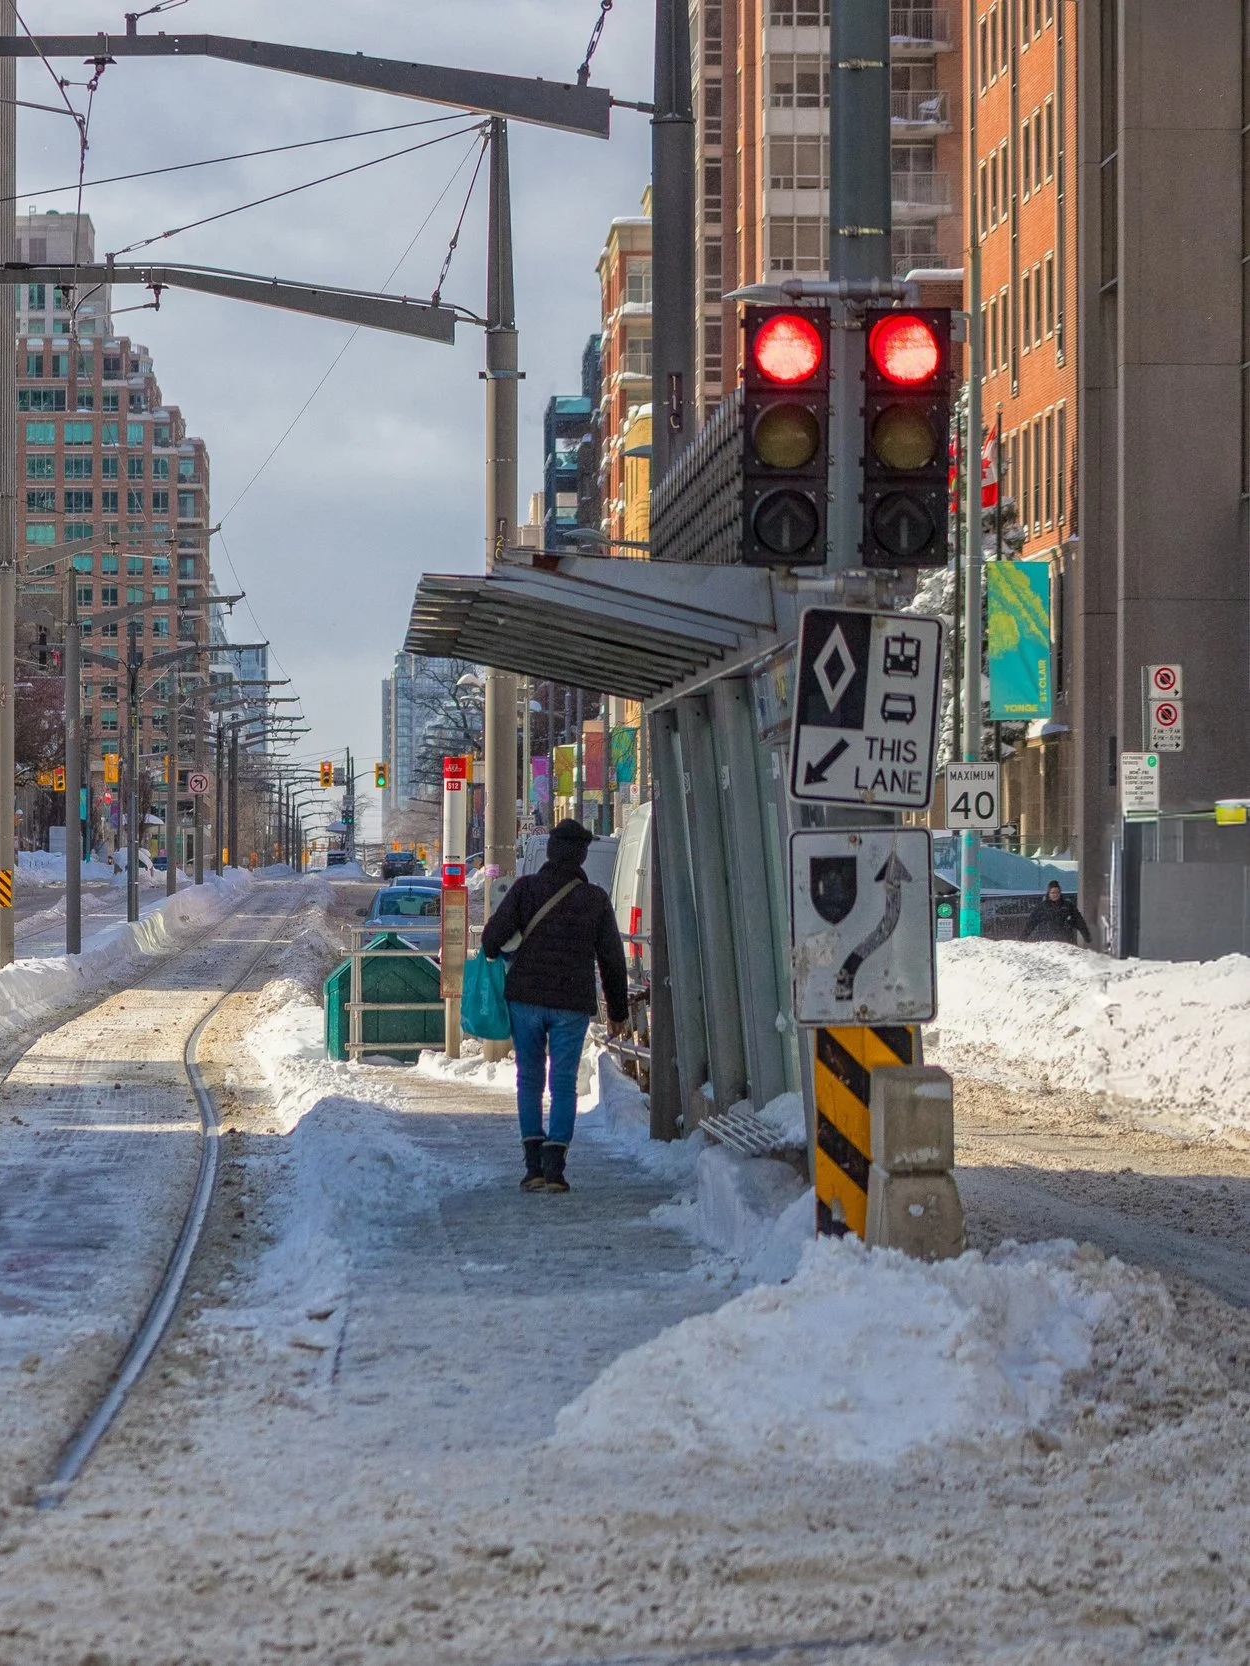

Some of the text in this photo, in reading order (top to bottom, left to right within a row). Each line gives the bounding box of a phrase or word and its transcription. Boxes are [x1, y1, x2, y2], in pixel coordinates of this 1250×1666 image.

[1004, 703, 1038, 713] YONGE
[865, 736, 918, 764] THIS
[853, 766, 923, 796] LANE
[949, 770, 996, 781] MAXIMUM
[447, 782, 460, 790] 512
[950, 791, 995, 820] 40
